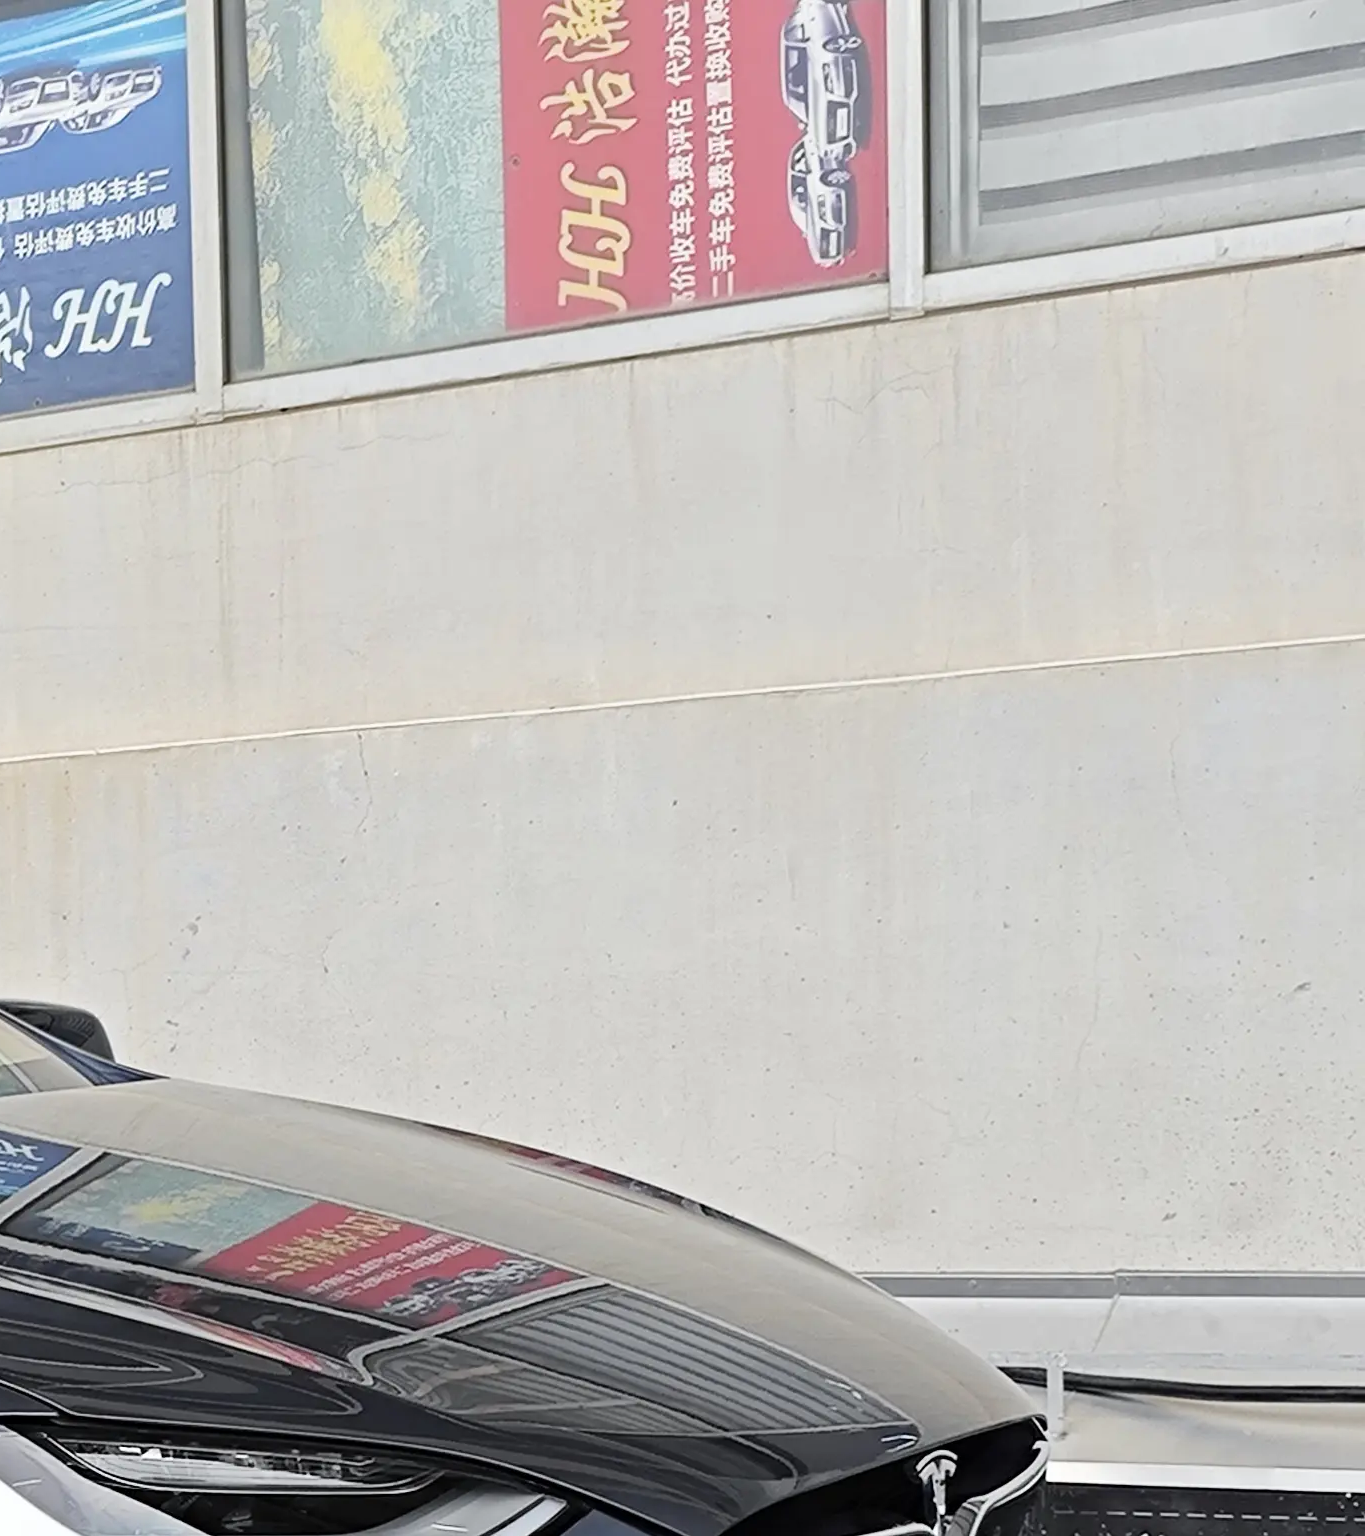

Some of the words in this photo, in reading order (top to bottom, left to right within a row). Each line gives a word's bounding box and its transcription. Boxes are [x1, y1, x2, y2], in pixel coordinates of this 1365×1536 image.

[13, 203, 179, 260] 高价收车免费评估
